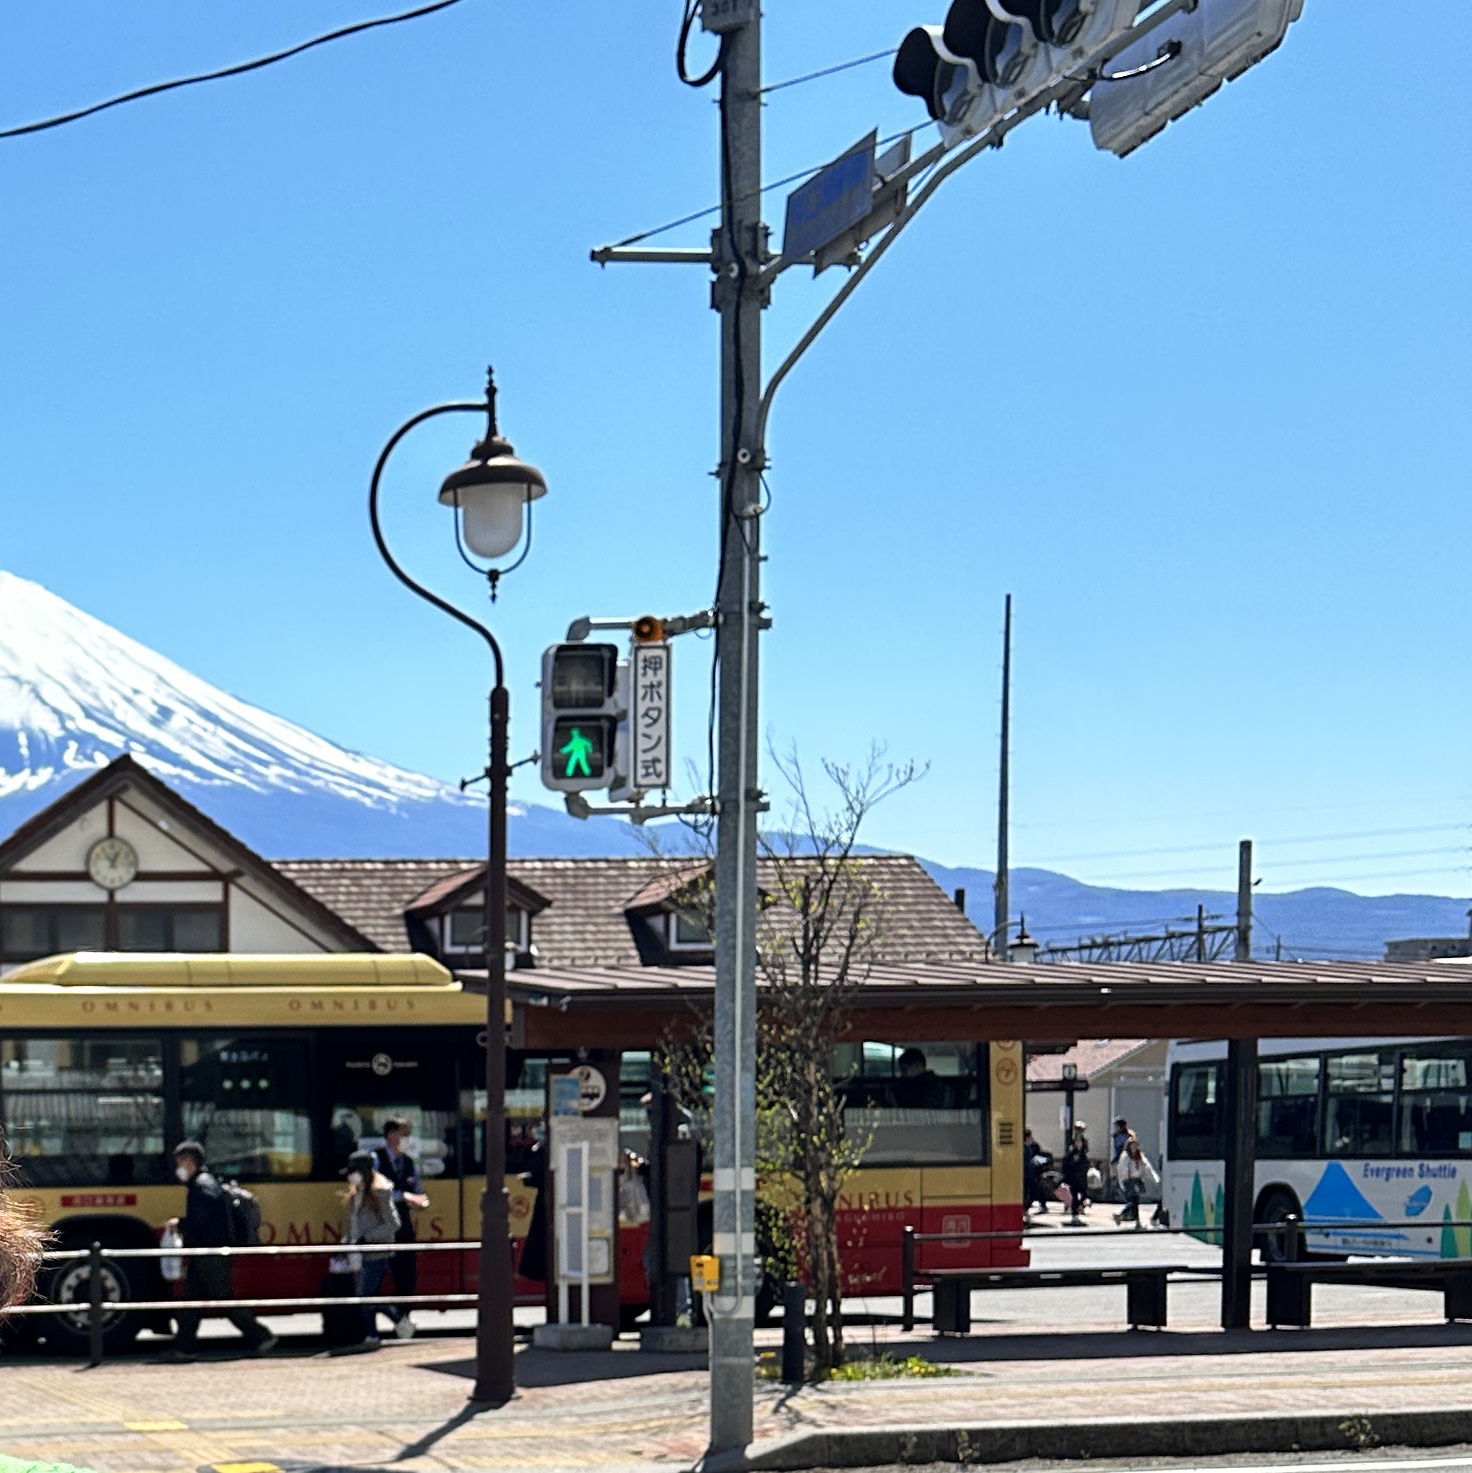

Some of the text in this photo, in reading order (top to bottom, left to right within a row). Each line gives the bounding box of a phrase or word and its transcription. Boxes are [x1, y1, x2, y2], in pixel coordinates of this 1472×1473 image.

[640, 654, 663, 780] 押ボタン式
[82, 1000, 213, 1013] OMNIBUS
[289, 999, 415, 1012] OMNIBUS
[1363, 1162, 1458, 1183] Evergreen Shuttle
